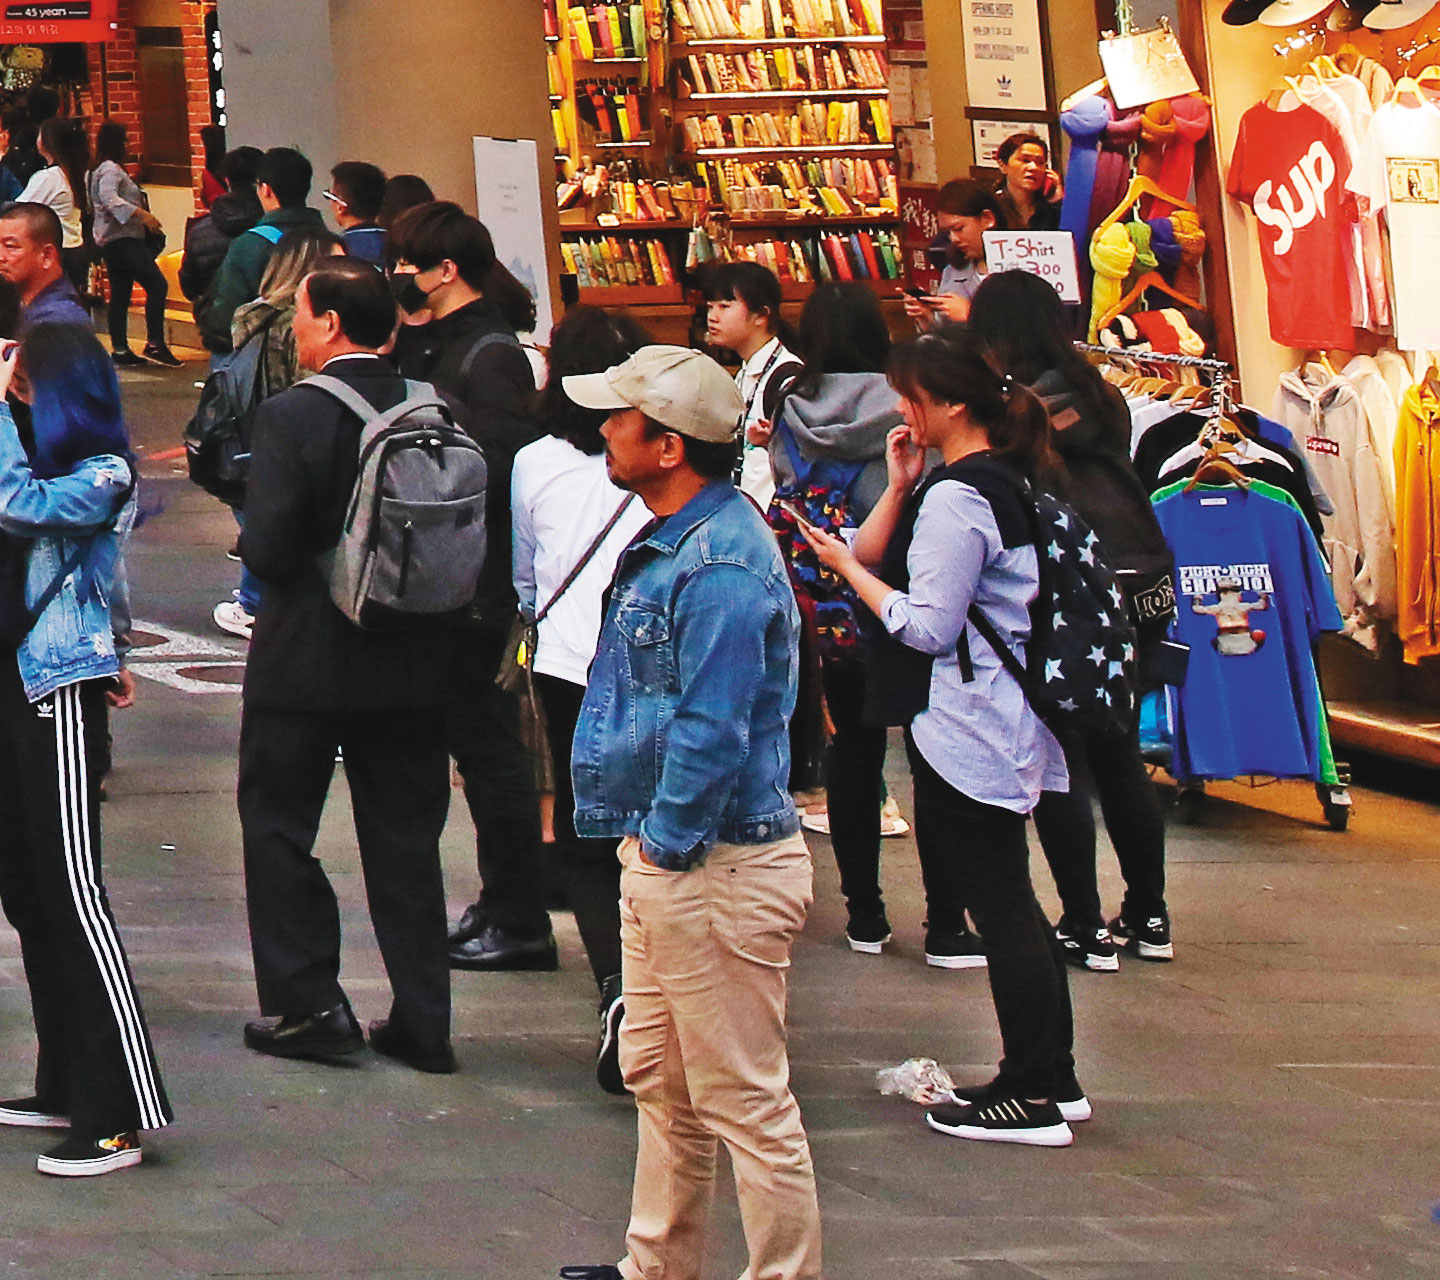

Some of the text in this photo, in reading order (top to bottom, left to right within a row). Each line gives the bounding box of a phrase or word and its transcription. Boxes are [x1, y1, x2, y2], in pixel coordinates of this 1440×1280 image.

[25, 7, 67, 19] 45 years
[1253, 138, 1336, 257] Sup
[991, 238, 1055, 260] T-Shirt
[1179, 564, 1269, 578] FIGHT NIGHT
[1180, 575, 1274, 594] CHAPION
